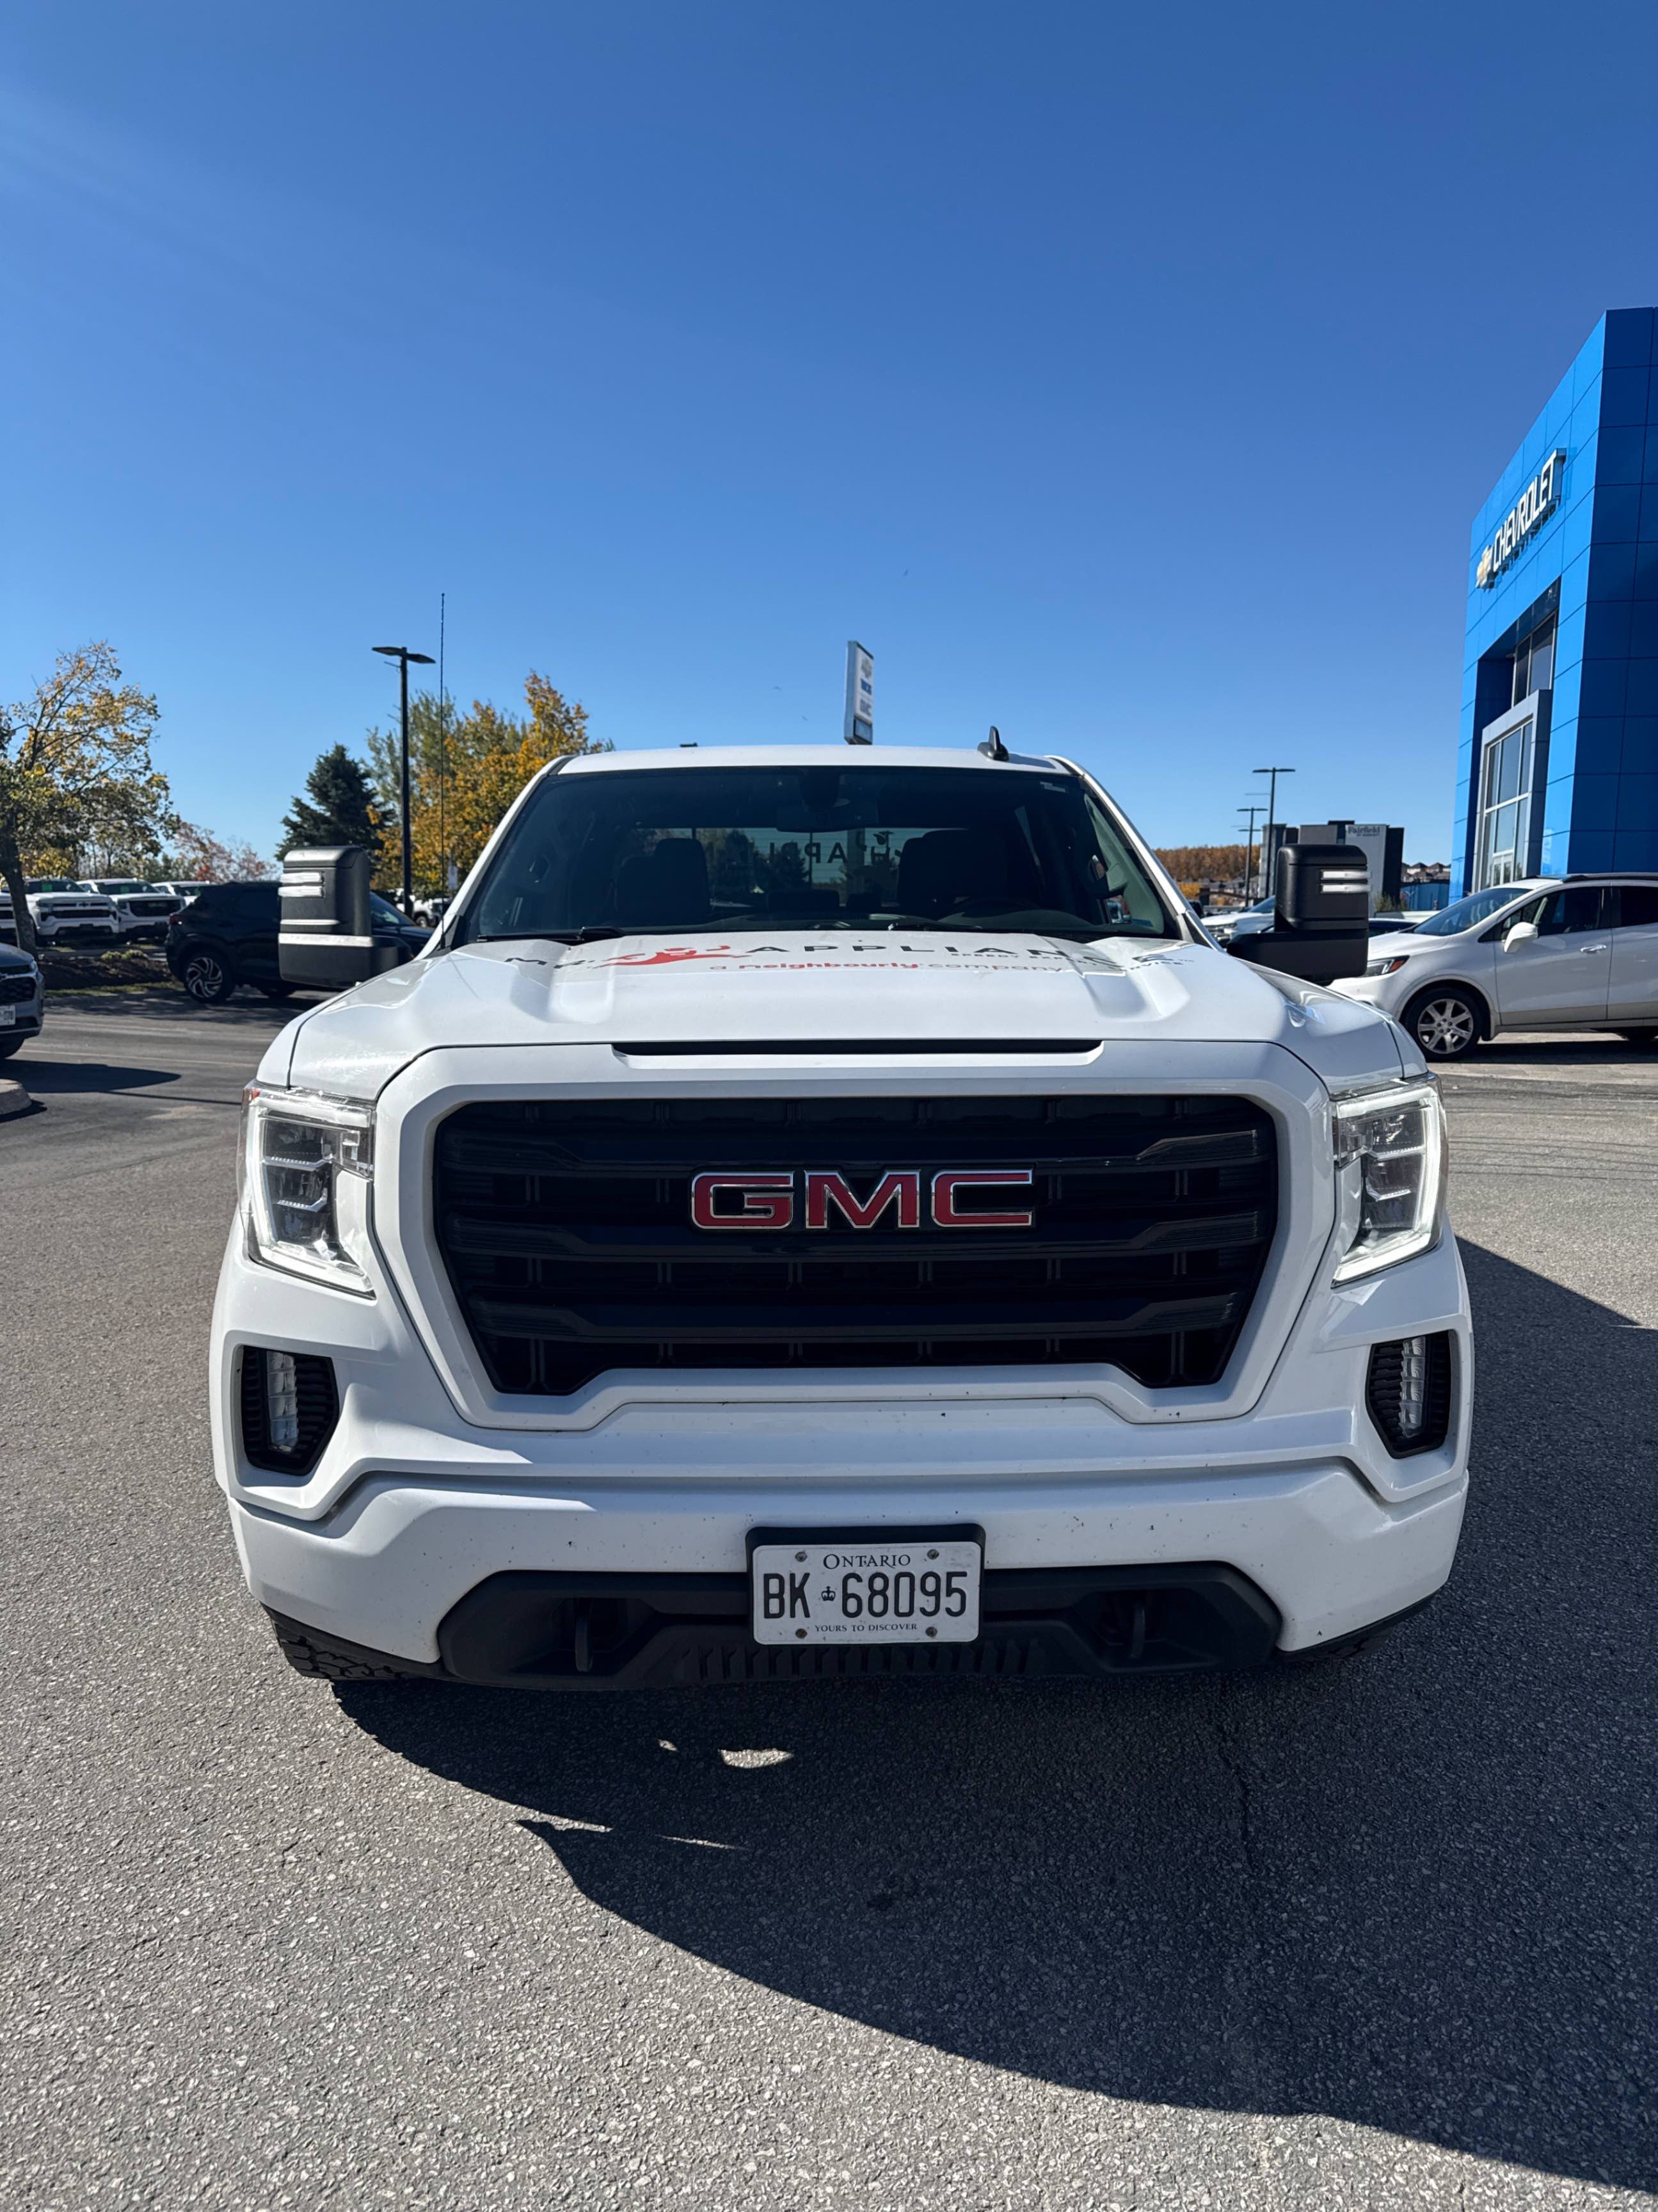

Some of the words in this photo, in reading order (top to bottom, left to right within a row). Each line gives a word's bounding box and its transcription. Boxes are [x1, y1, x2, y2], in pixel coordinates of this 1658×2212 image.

[1493, 449, 1558, 573] CHEVROLET
[691, 1169, 1033, 1230] GMC
[823, 1554, 911, 1569] ONTARIO
[763, 1573, 811, 1619] BK
[841, 1571, 968, 1617] 68095
[815, 1624, 847, 1632] YOURS
[868, 1623, 917, 1631] DISCOVER
